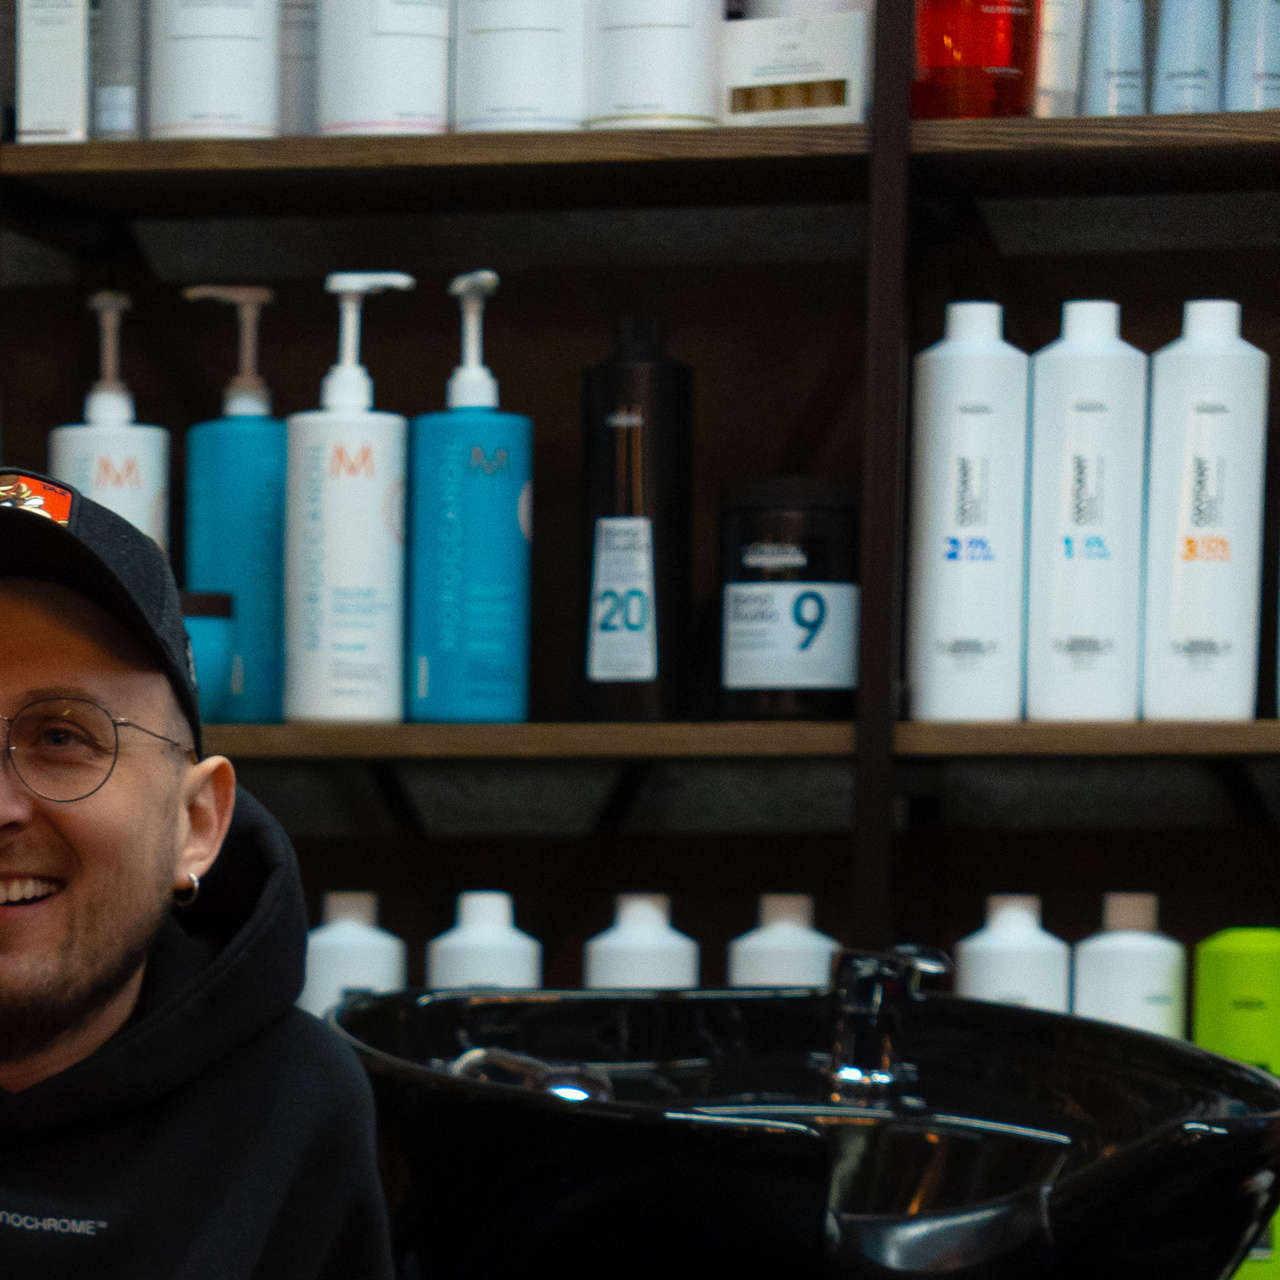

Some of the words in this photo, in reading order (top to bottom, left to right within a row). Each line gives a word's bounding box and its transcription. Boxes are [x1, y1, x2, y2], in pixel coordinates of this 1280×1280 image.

[94, 455, 141, 488] M
[330, 444, 376, 478] M
[468, 446, 510, 475] M
[598, 588, 648, 632] 20
[792, 590, 826, 651] 9
